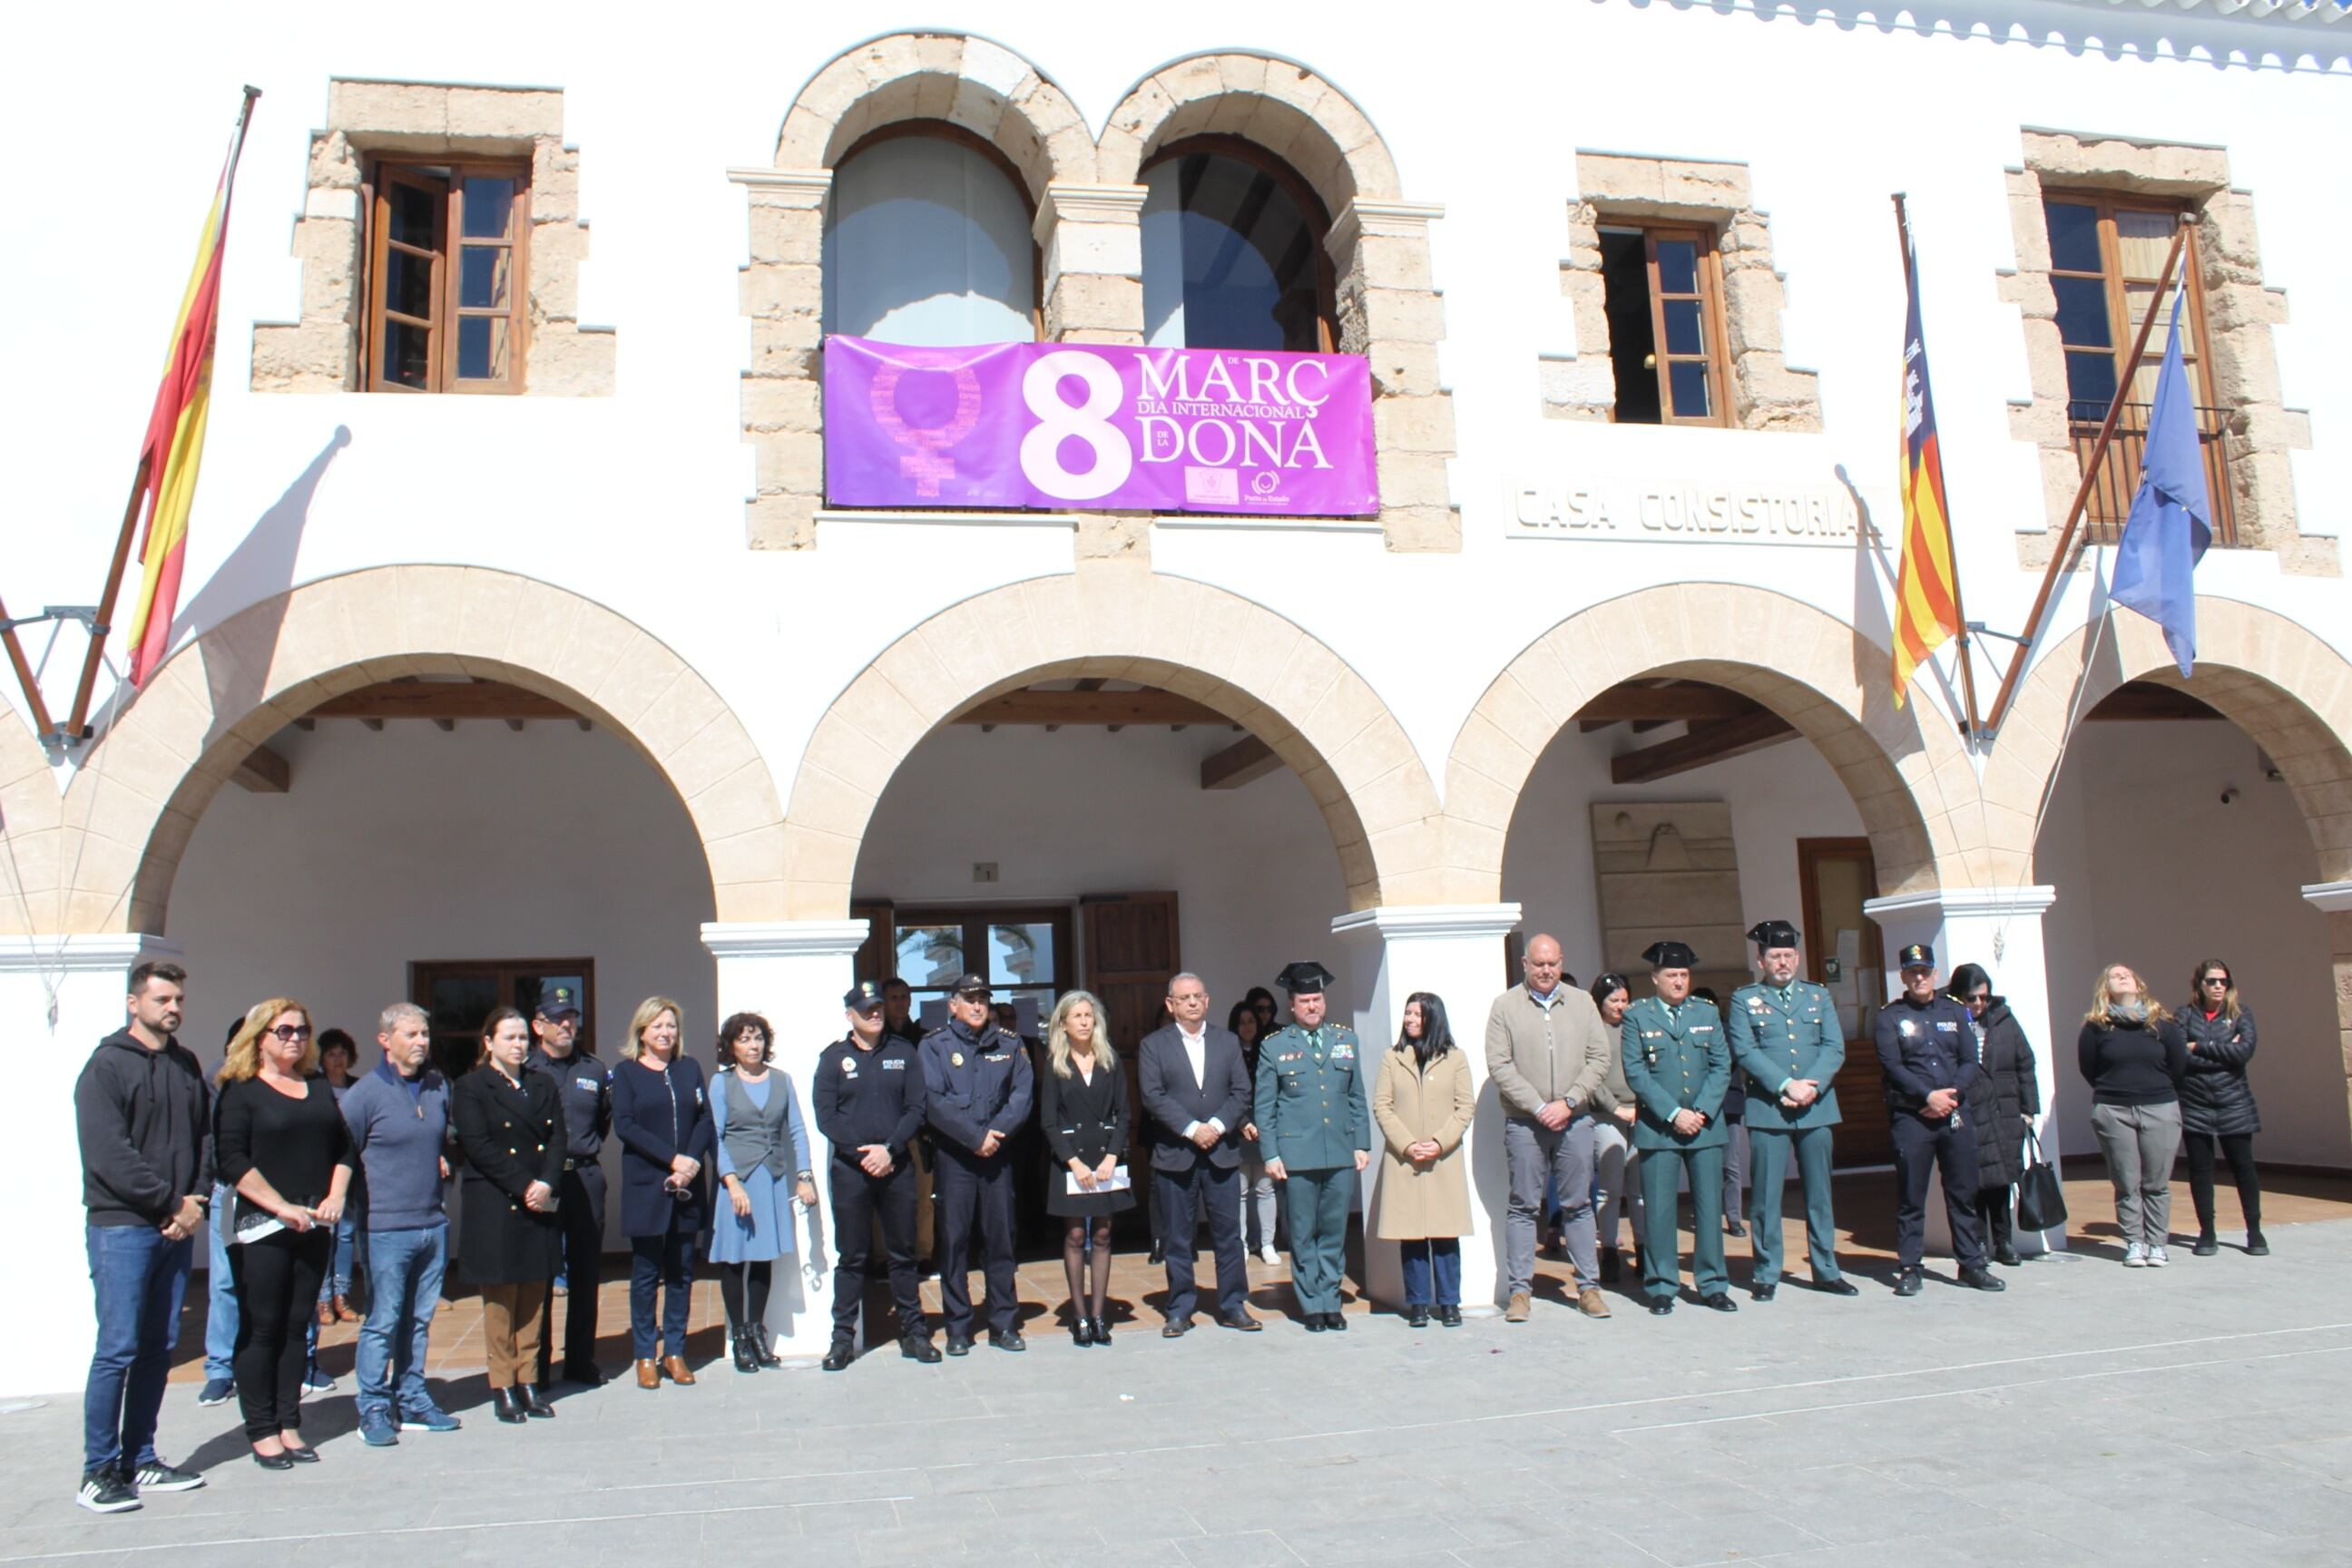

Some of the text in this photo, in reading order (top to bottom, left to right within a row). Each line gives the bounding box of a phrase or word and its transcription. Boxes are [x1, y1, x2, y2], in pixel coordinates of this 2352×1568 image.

[1227, 357, 1240, 365] DE
[1133, 353, 1329, 418] MARÇ
[1019, 350, 1133, 500] 8
[1137, 401, 1306, 419] DIA INTERNACIONAL
[1138, 416, 1334, 470] DONA
[1157, 438, 1169, 446] LA
[1515, 486, 1616, 530] CASA
